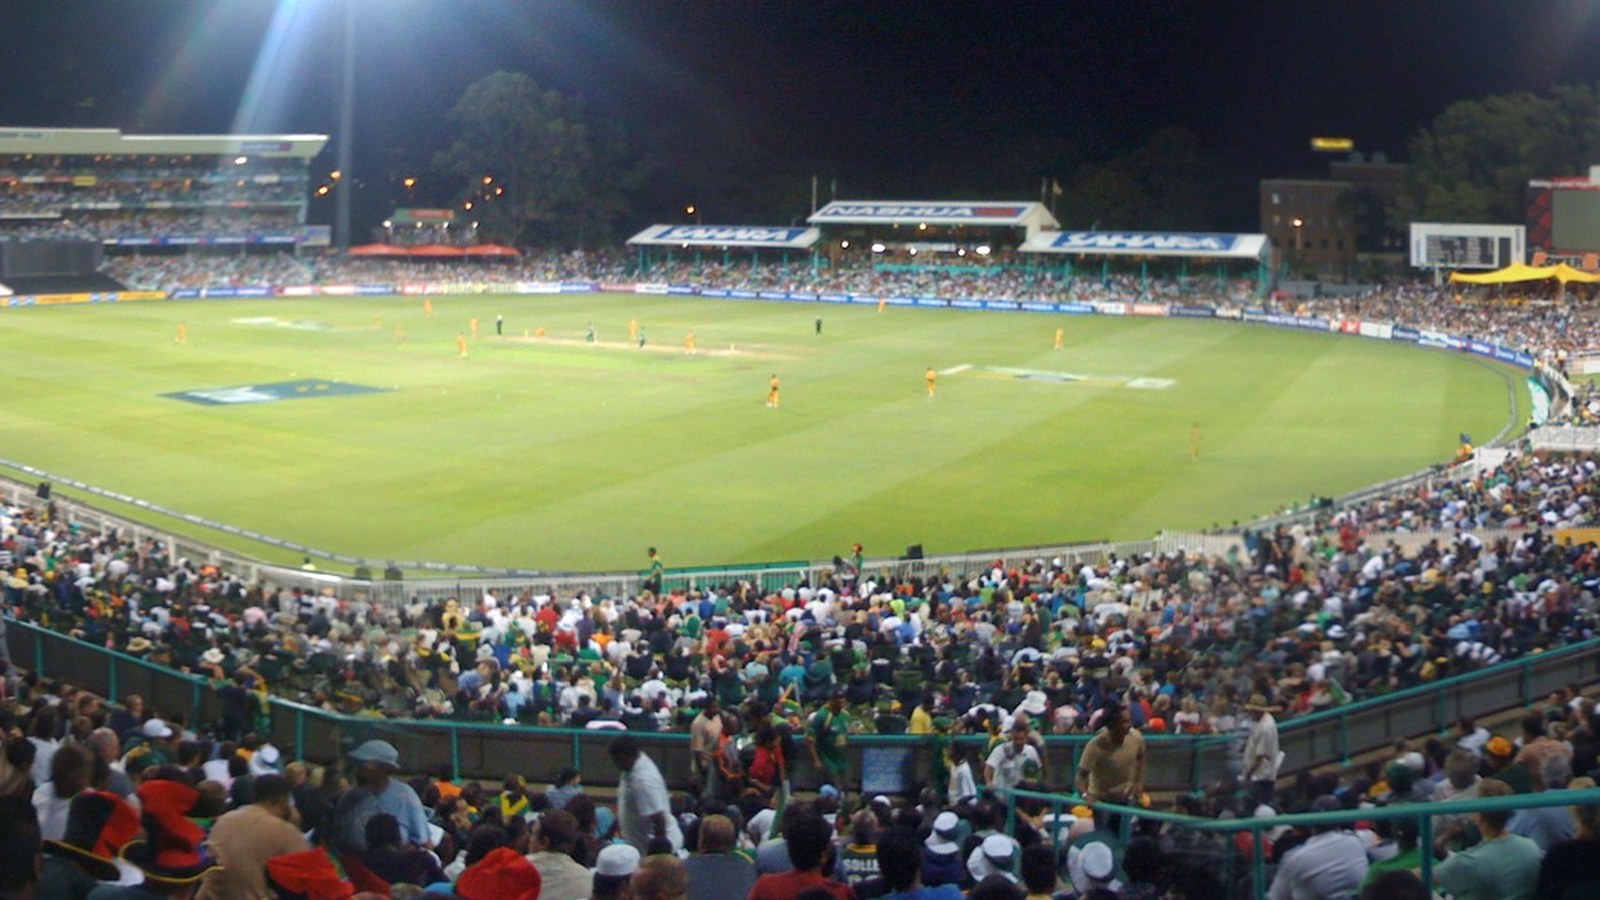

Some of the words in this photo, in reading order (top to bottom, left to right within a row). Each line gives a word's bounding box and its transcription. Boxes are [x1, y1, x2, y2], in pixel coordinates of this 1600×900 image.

[825, 205, 973, 217] NASHUA
[664, 226, 789, 242] SAHARA
[1062, 232, 1221, 249] SAHARA
